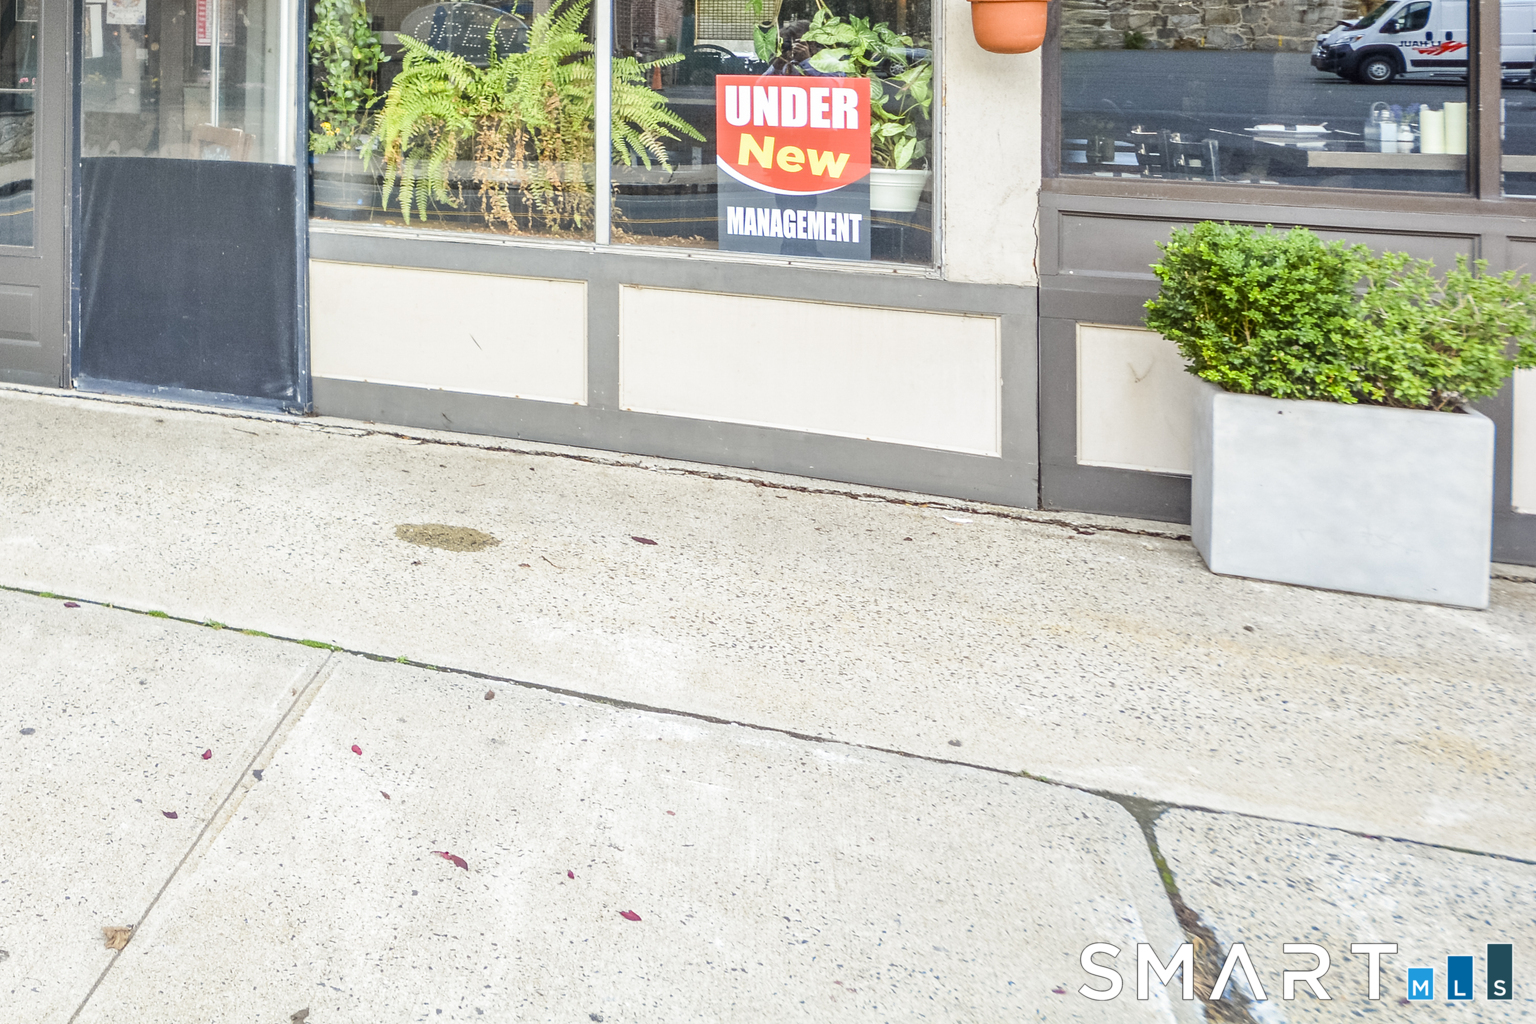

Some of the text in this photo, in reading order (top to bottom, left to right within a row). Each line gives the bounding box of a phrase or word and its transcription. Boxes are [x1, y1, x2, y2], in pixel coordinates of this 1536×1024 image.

[413, 20, 518, 51] OPEN
[724, 84, 859, 130] UNDER
[737, 132, 851, 179] New
[726, 205, 863, 244] MANAGEMENT
